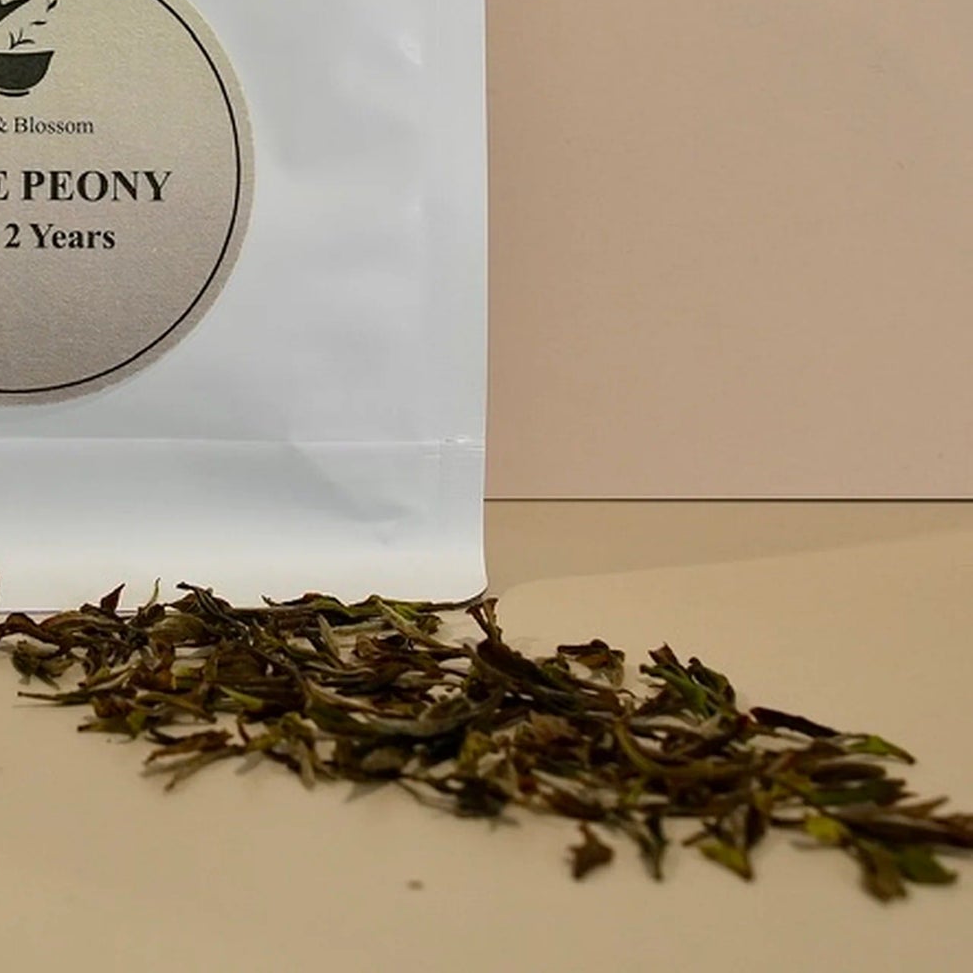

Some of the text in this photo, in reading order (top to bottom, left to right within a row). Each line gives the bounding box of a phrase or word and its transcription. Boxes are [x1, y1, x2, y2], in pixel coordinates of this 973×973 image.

[13, 116, 94, 134] Blossom
[21, 169, 173, 202] PEONY
[4, 222, 21, 249] 2
[27, 222, 116, 250] Years
